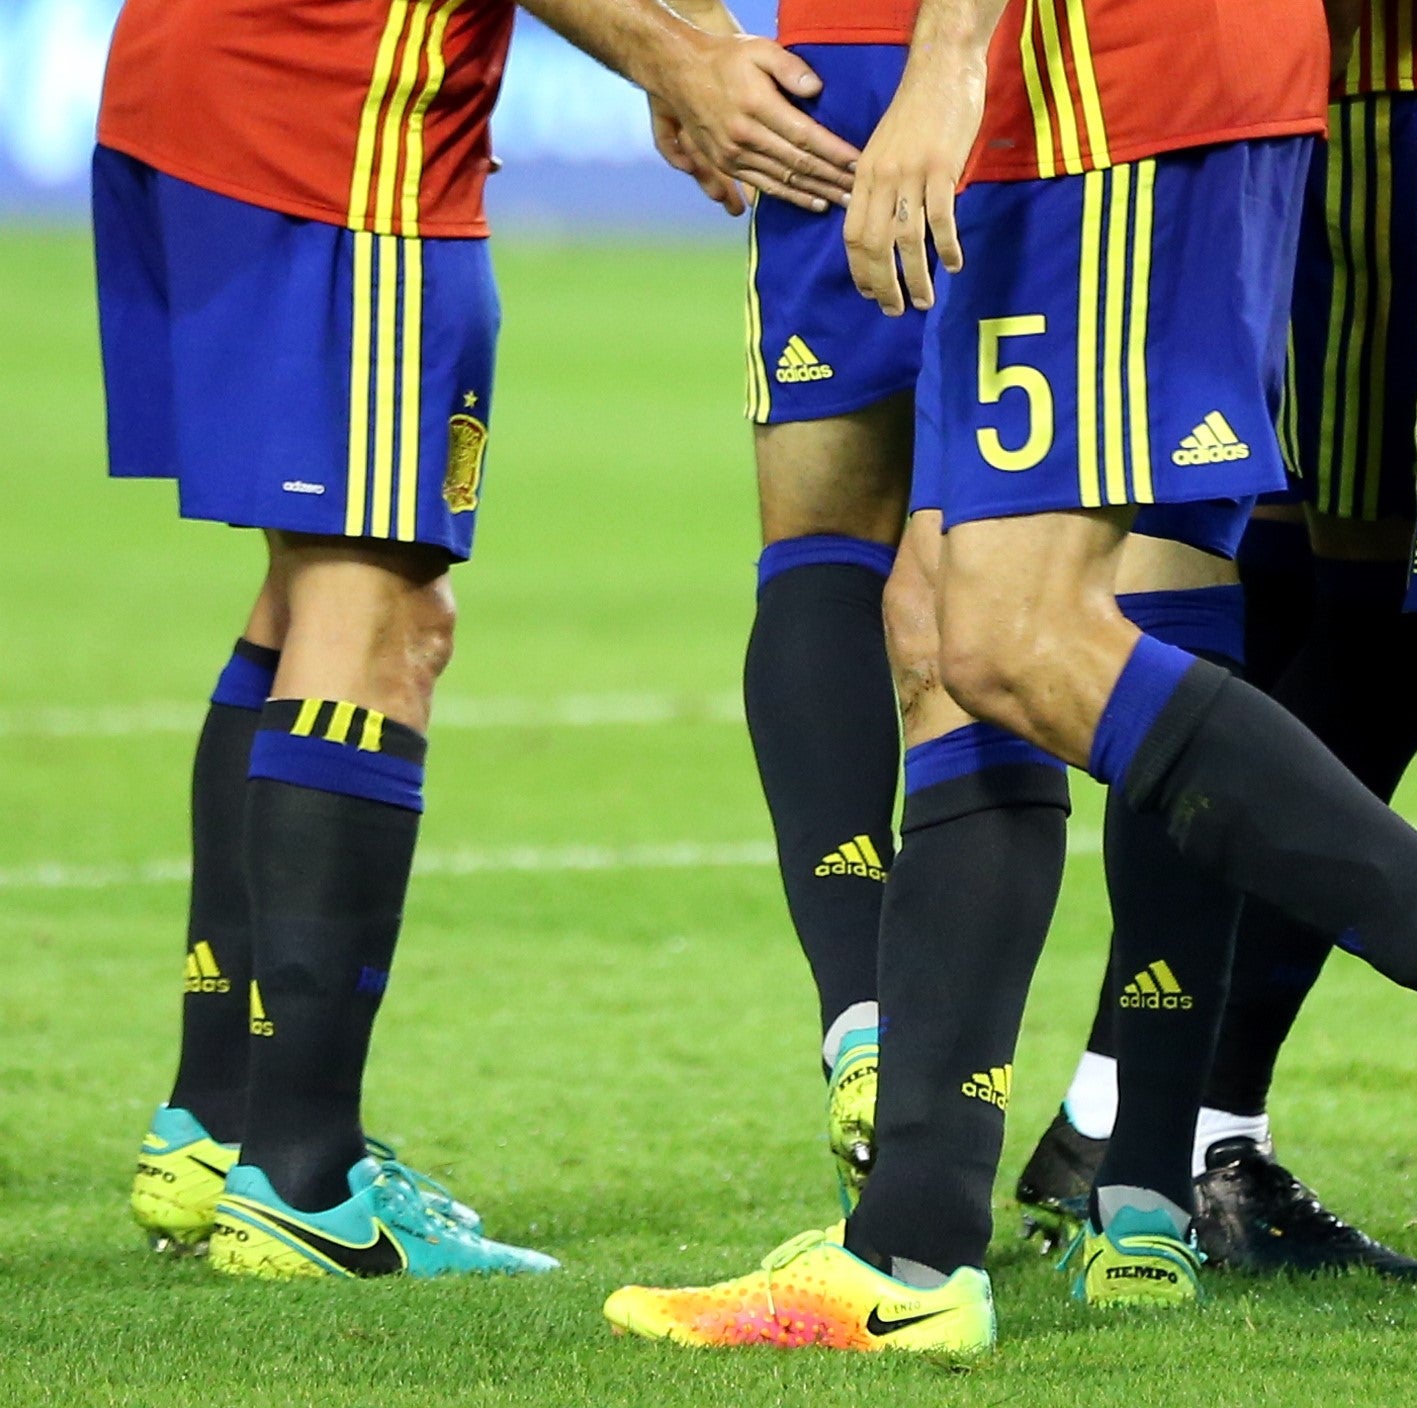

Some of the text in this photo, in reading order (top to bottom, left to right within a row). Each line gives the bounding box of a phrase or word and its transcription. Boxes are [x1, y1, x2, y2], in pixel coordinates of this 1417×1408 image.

[775, 364, 834, 383] adidas
[976, 314, 1054, 472] 5
[1171, 443, 1250, 466] adidas
[1119, 992, 1194, 1010] adidas
[961, 1081, 1009, 1111] adid
[1105, 1265, 1178, 1285] TIEMPO
